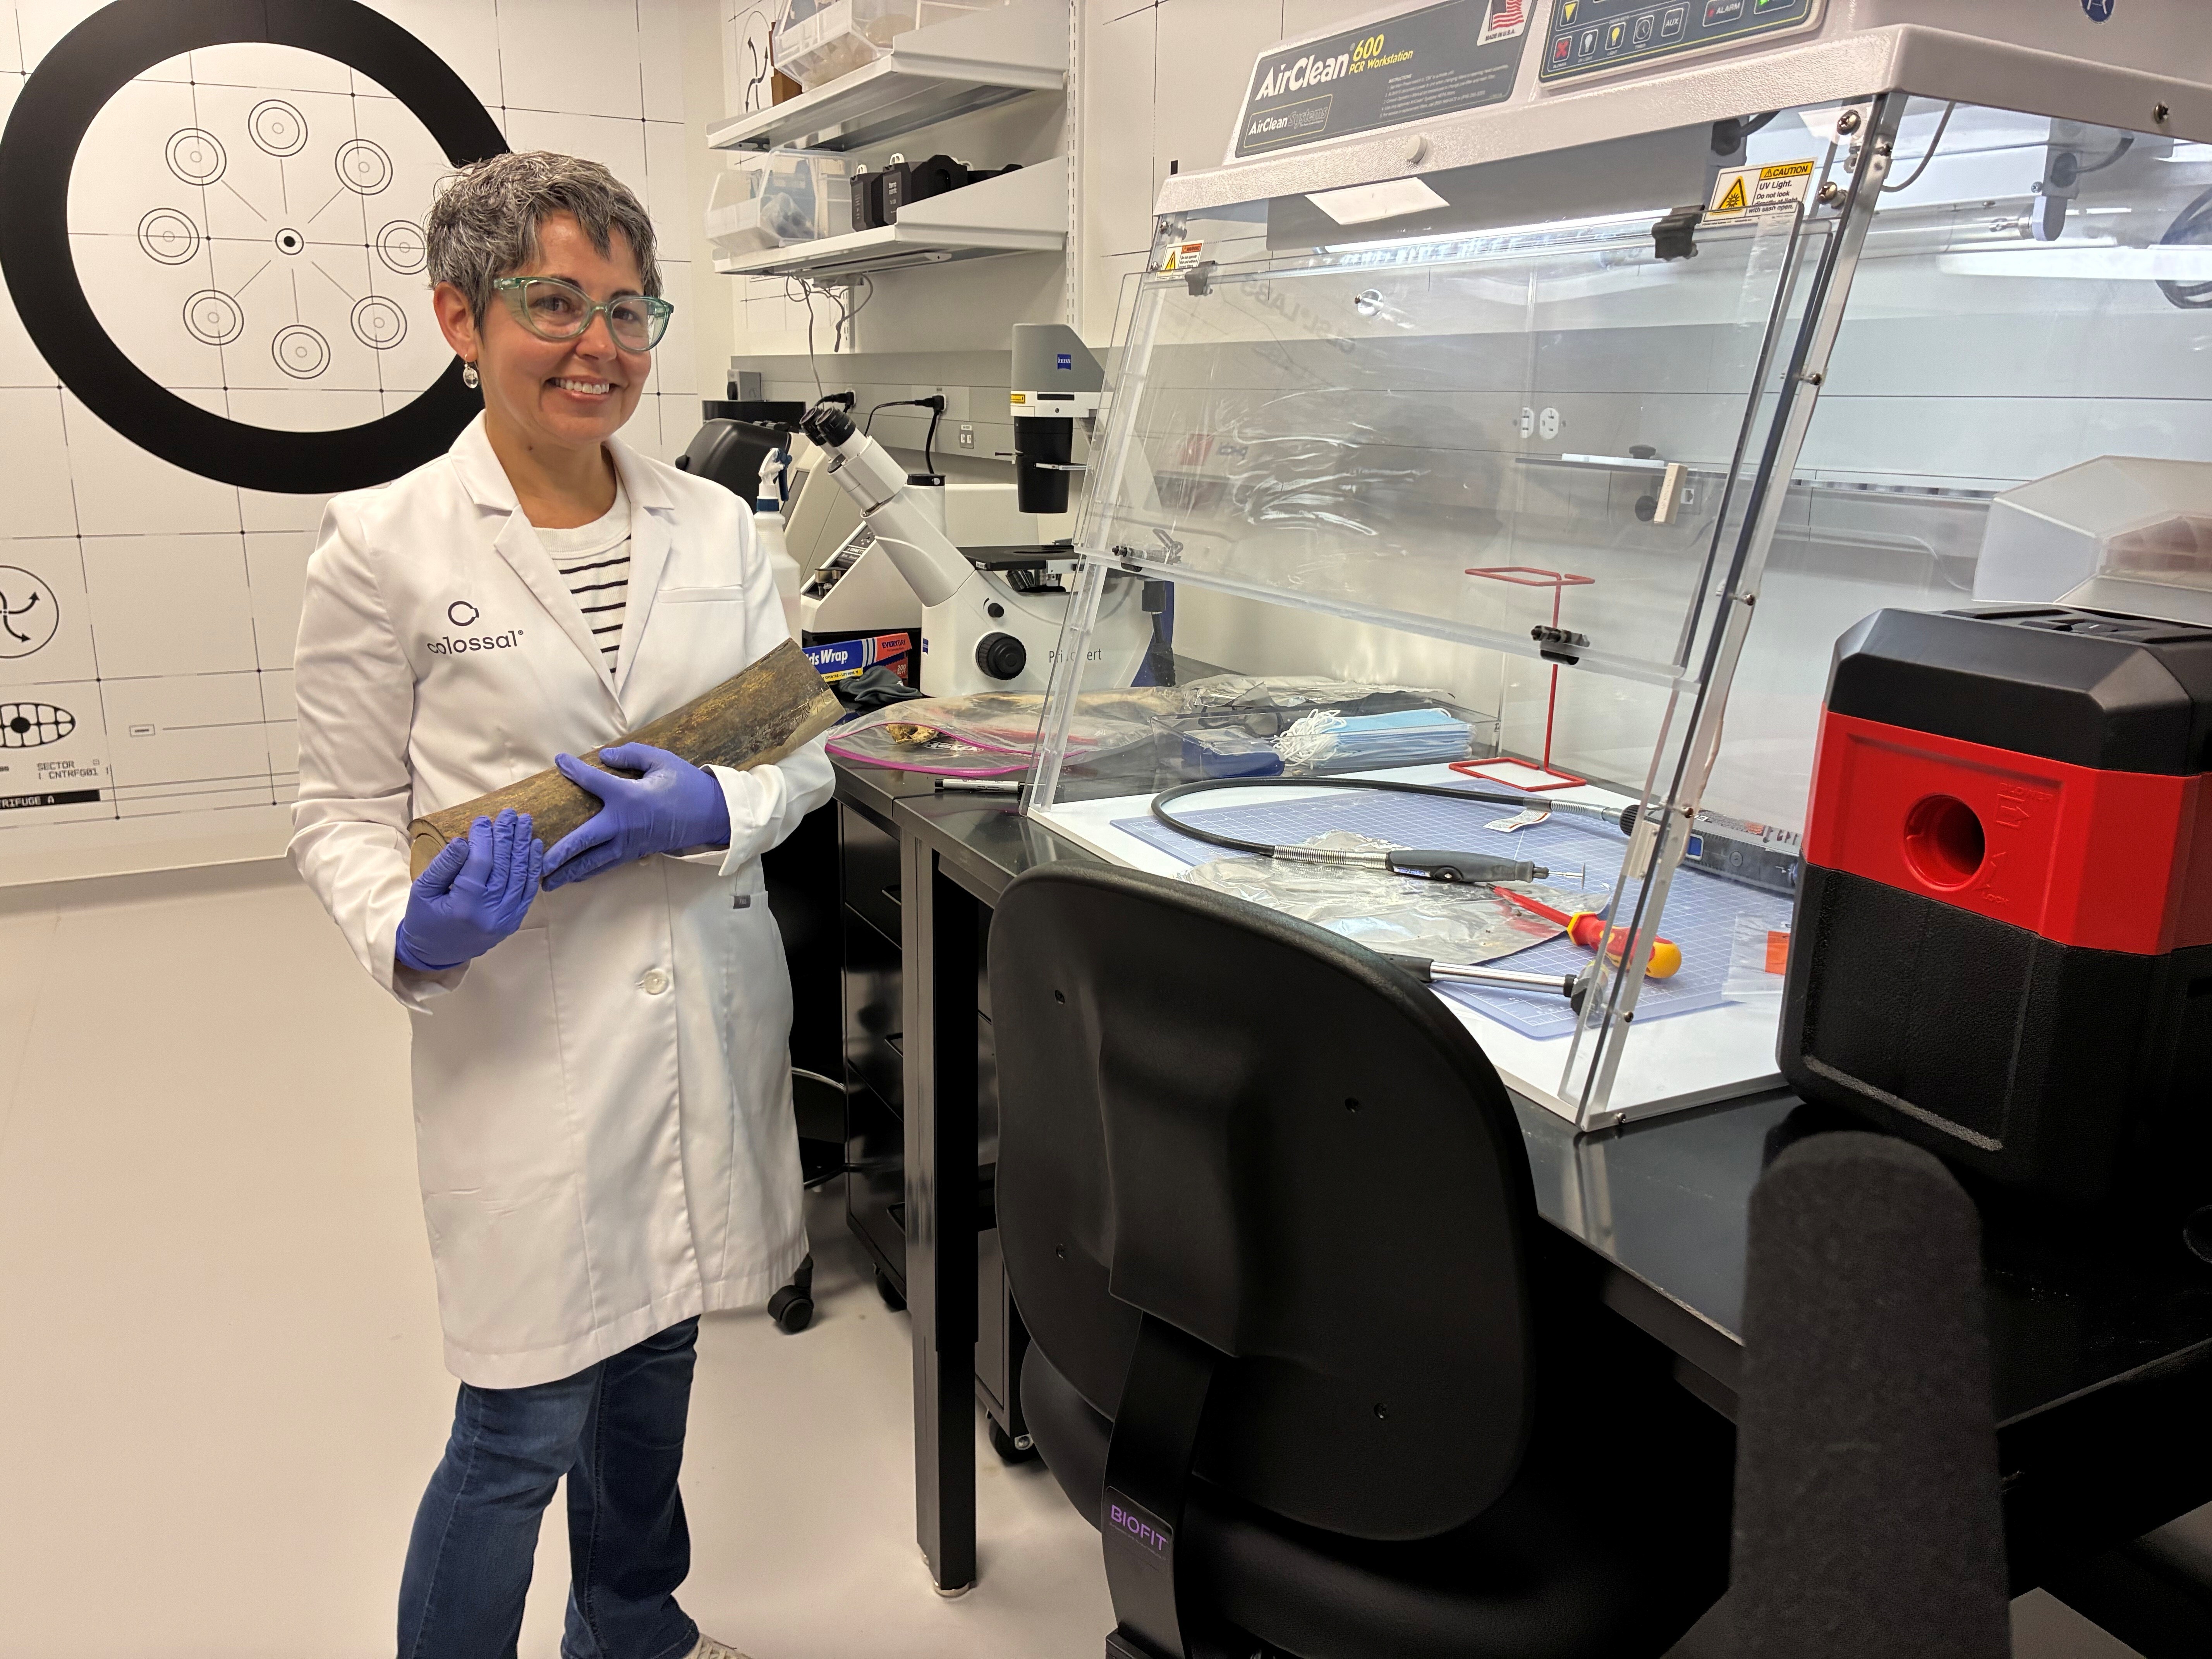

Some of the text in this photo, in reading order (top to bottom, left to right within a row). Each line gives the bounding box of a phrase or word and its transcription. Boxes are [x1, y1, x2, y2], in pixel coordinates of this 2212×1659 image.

[1716, 2, 1741, 14] ALARM
[1665, 17, 1679, 27] AUX
[1485, 33, 1497, 41] MADE
[1255, 53, 1349, 100] AirClean
[1353, 34, 1384, 62] 600
[1348, 50, 1413, 75] PCR Workstation
[1248, 107, 1328, 136] AirClean Systems
[1773, 165, 1808, 177] CAUTION
[1772, 180, 1792, 189] Light.
[881, 639, 906, 648] EVERYDAY
[820, 648, 848, 665] Wrap
[37, 760, 75, 771] SECTOR
[47, 795, 55, 804] A
[1111, 1504, 1167, 1551] BIOFIT
